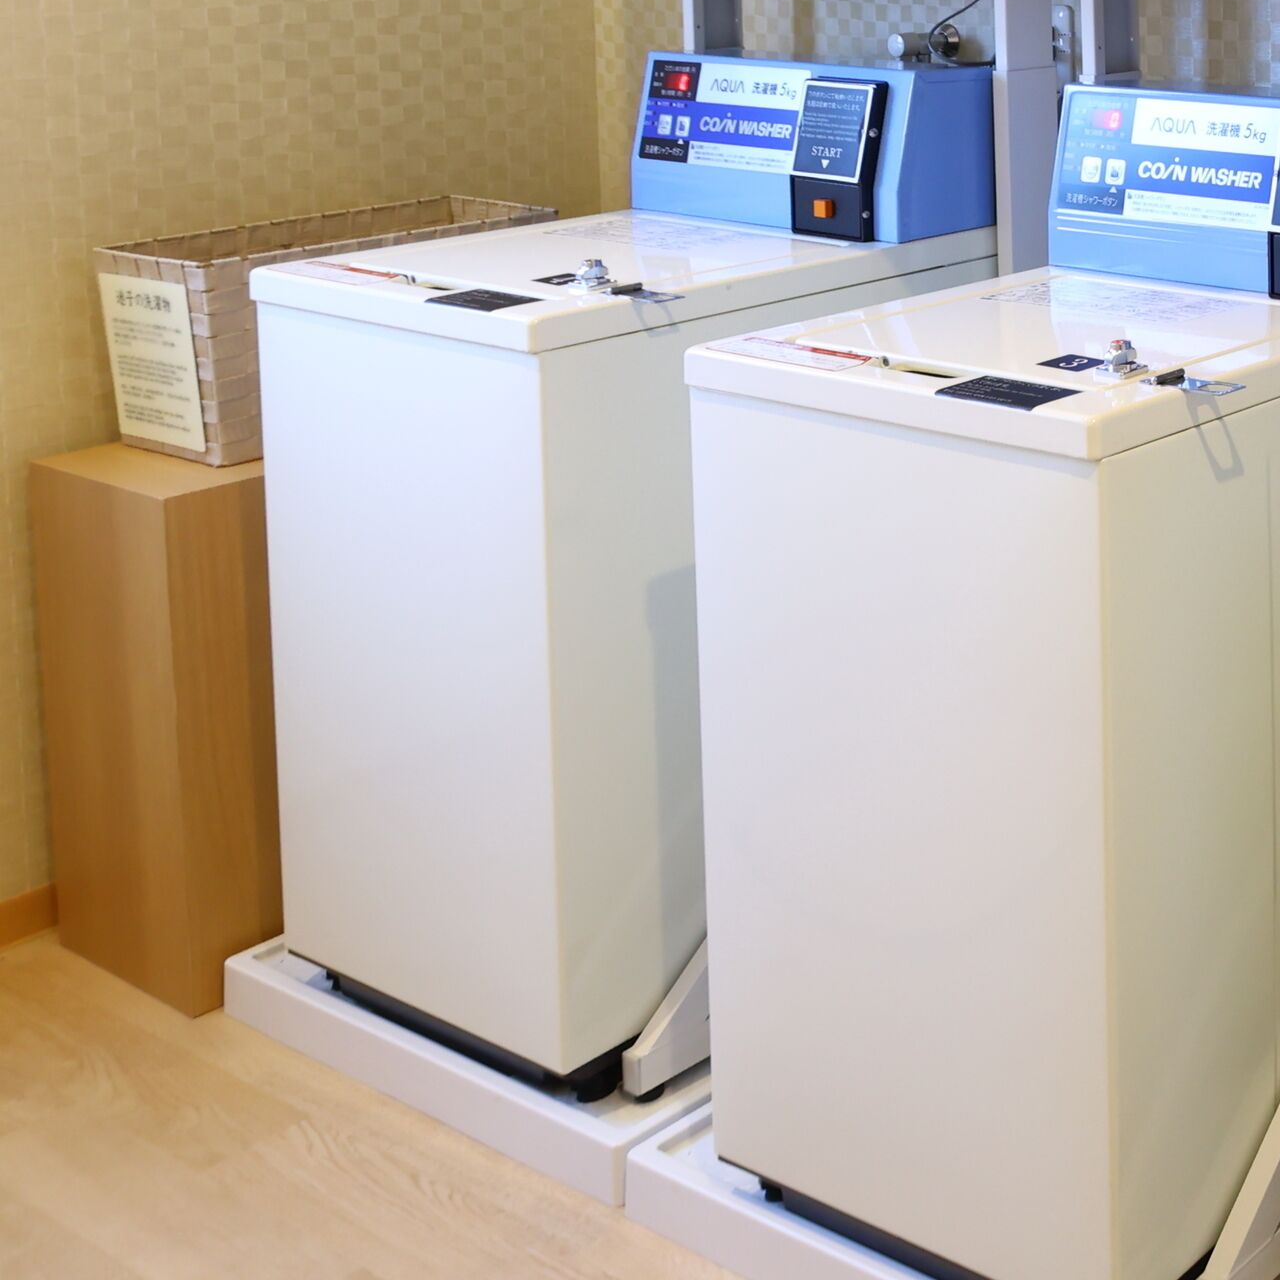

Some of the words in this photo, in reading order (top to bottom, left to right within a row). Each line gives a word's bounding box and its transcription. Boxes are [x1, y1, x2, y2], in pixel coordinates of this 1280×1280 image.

[710, 78, 745, 94] AQUA
[752, 82, 778, 96] 洗濯機
[779, 82, 797, 100] 5kg
[700, 112, 737, 134] COIN
[739, 121, 792, 139] WASHER
[1109, 112, 1120, 128] 0
[1151, 117, 1196, 135] AQUA
[1206, 121, 1241, 138] 洗濯機
[1243, 123, 1267, 144] 5kg
[811, 145, 843, 158] START
[1138, 157, 1187, 182] COIN
[1191, 166, 1263, 189] WASHER
[1057, 356, 1089, 369] 3
